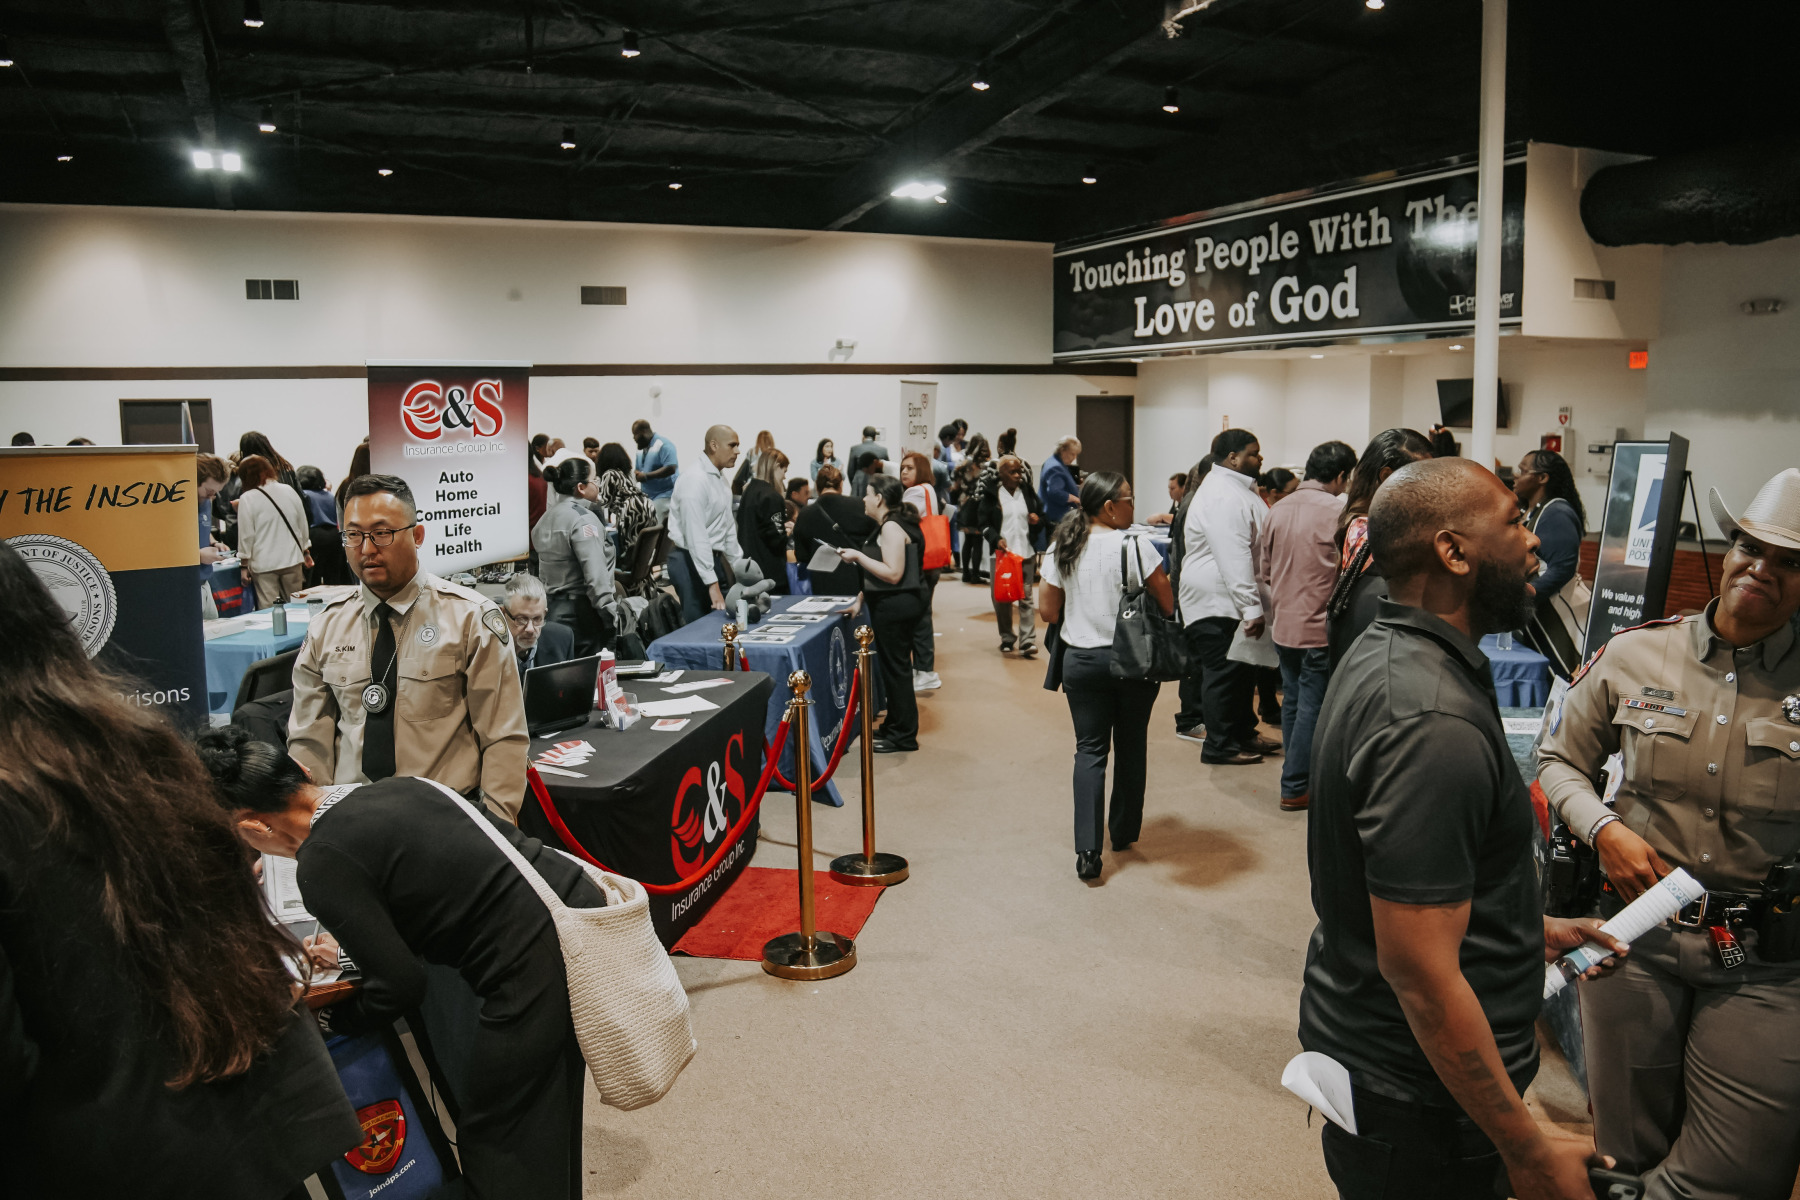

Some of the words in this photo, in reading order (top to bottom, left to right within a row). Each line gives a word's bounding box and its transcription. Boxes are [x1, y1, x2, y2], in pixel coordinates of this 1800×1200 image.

[1070, 248, 1185, 292] Touching
[1195, 222, 1299, 275] People
[1309, 207, 1392, 254] With
[1134, 296, 1215, 337] Love
[1227, 291, 1259, 327] of
[1270, 266, 1359, 324] God
[406, 444, 454, 456] Insurance
[457, 442, 487, 455] Group
[489, 442, 506, 452] Inc.
[439, 471, 474, 484] Auto
[17, 486, 73, 515] THE
[85, 479, 190, 510] INSIDE
[436, 489, 478, 502] Home
[416, 503, 501, 522] Commercial
[445, 523, 472, 537] Life
[435, 539, 482, 556] Health
[1633, 537, 1652, 548] UNI
[42, 549, 60, 558] OF
[60, 555, 99, 591] JUSTICE
[1601, 588, 1614, 599] We
[1615, 592, 1635, 603] value
[1608, 605, 1624, 616] and
[81, 603, 102, 642] RISONS
[672, 876, 712, 921] Insurance
[713, 854, 735, 882] Group
[369, 1159, 416, 1198] joindps.com
